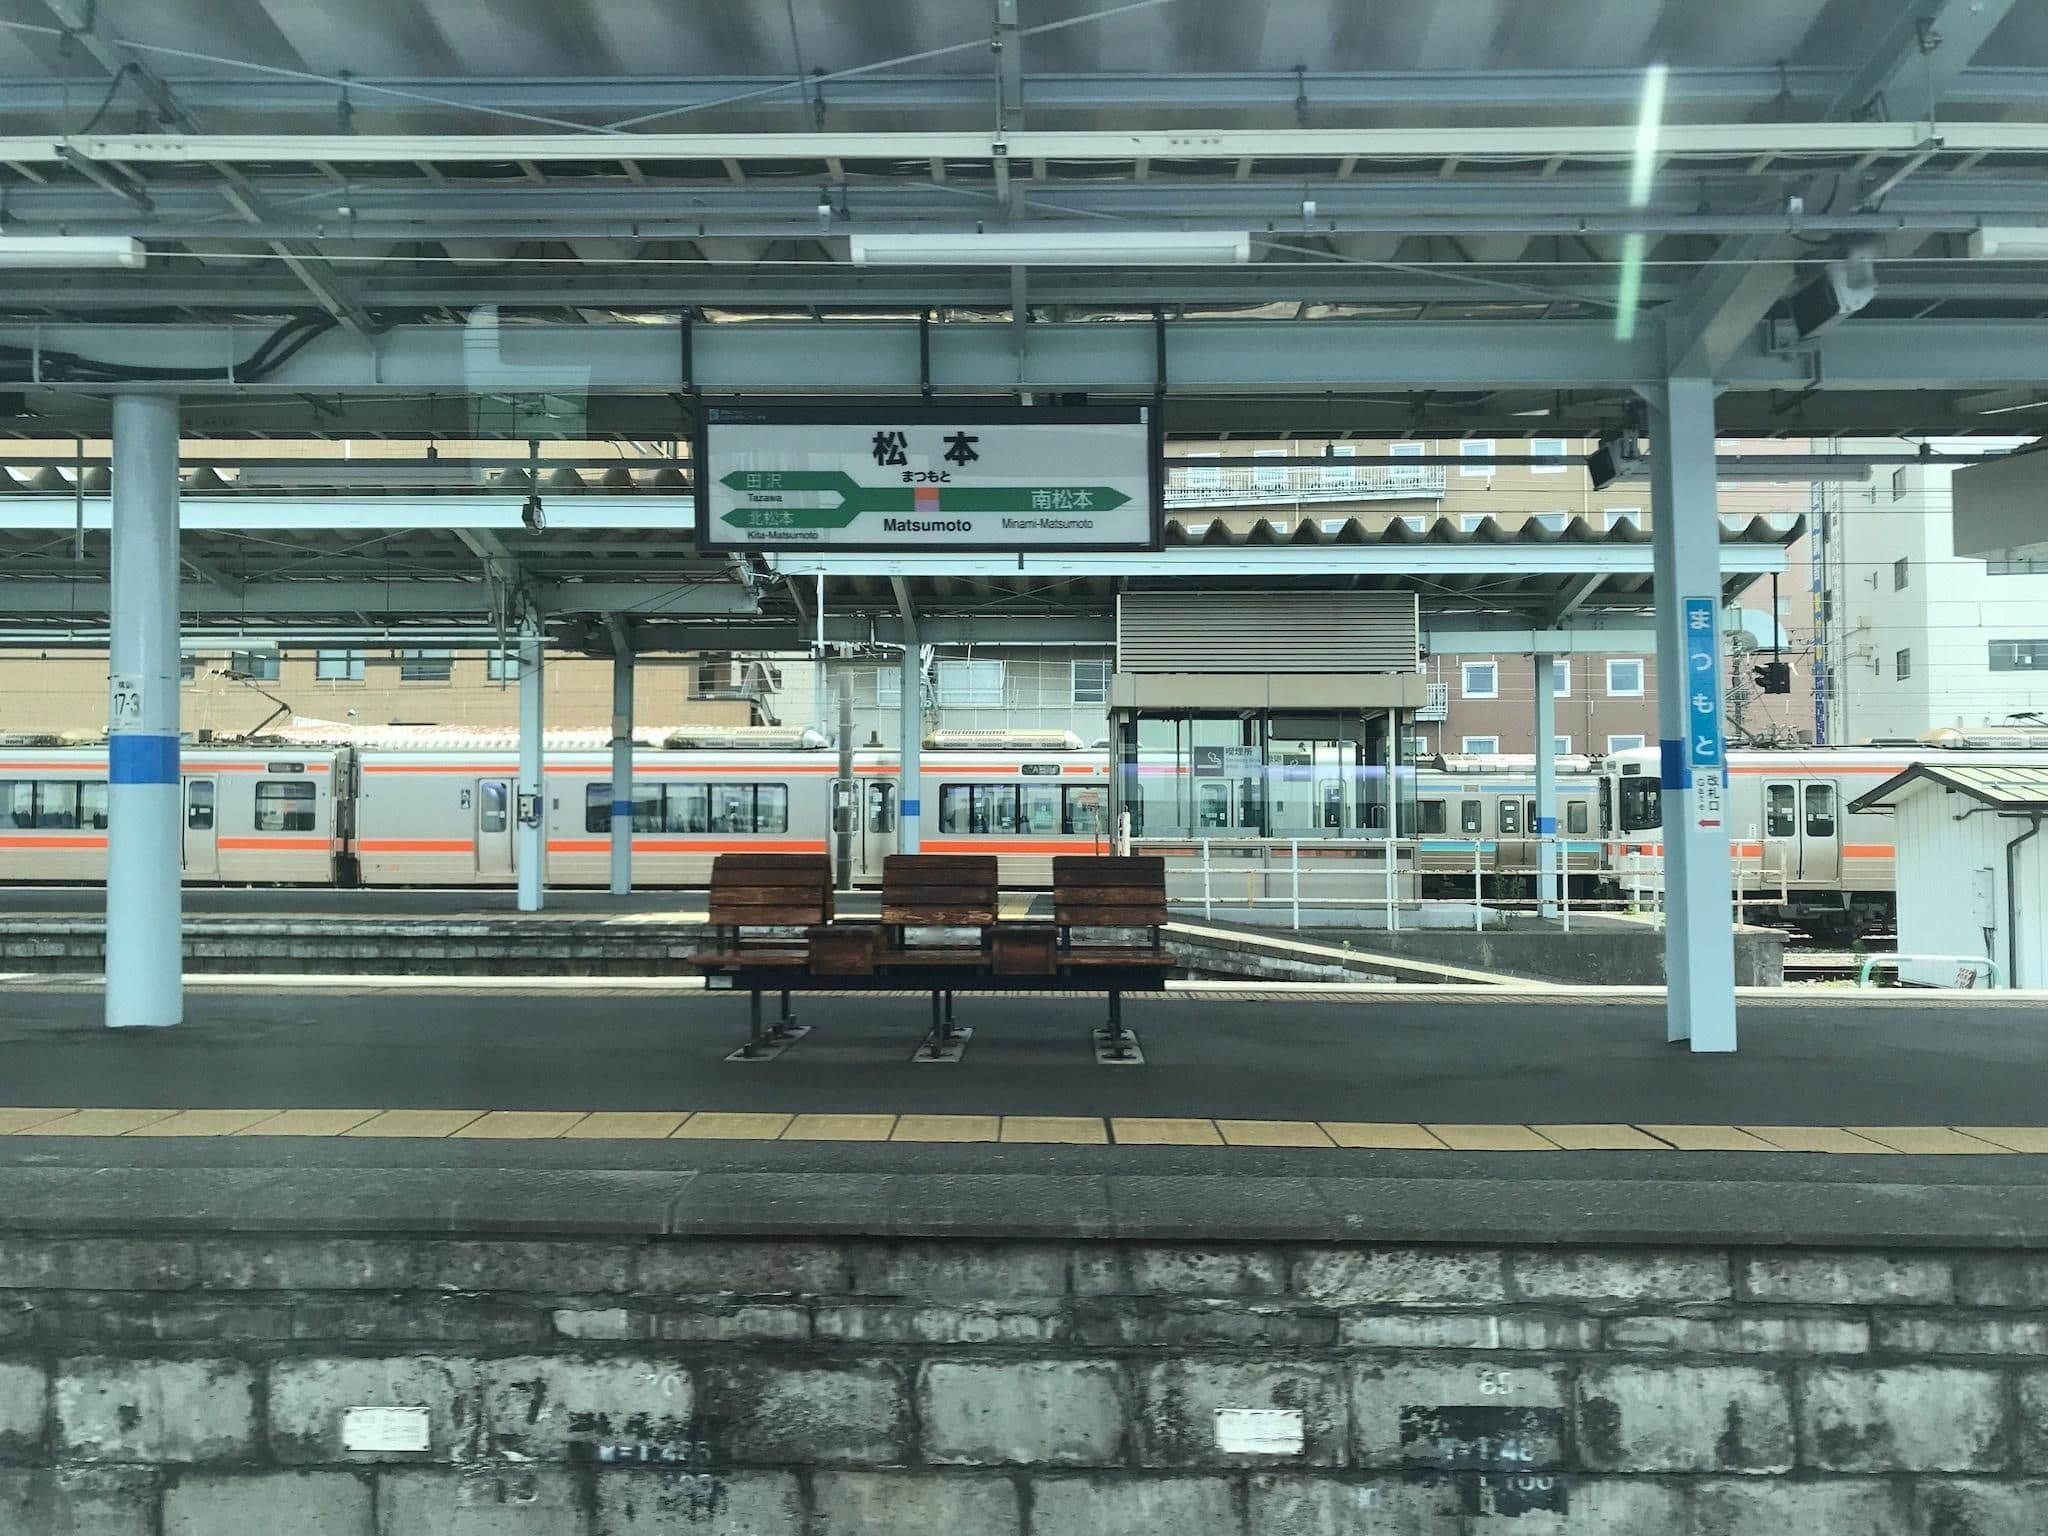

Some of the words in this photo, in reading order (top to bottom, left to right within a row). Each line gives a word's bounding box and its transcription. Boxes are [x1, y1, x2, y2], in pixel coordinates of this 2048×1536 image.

[872, 431, 979, 467] 松本
[746, 473, 783, 489] 田沢
[902, 470, 951, 483] まつもと
[747, 492, 783, 502] Tazawa
[1031, 489, 1093, 510] 南松本
[747, 511, 794, 526] 北松本
[883, 518, 972, 532] Matsumoto
[1002, 518, 1094, 529] Minami-Matsumoto
[747, 531, 818, 539] Kita-Matsumoto
[1689, 608, 1714, 756] まつもと
